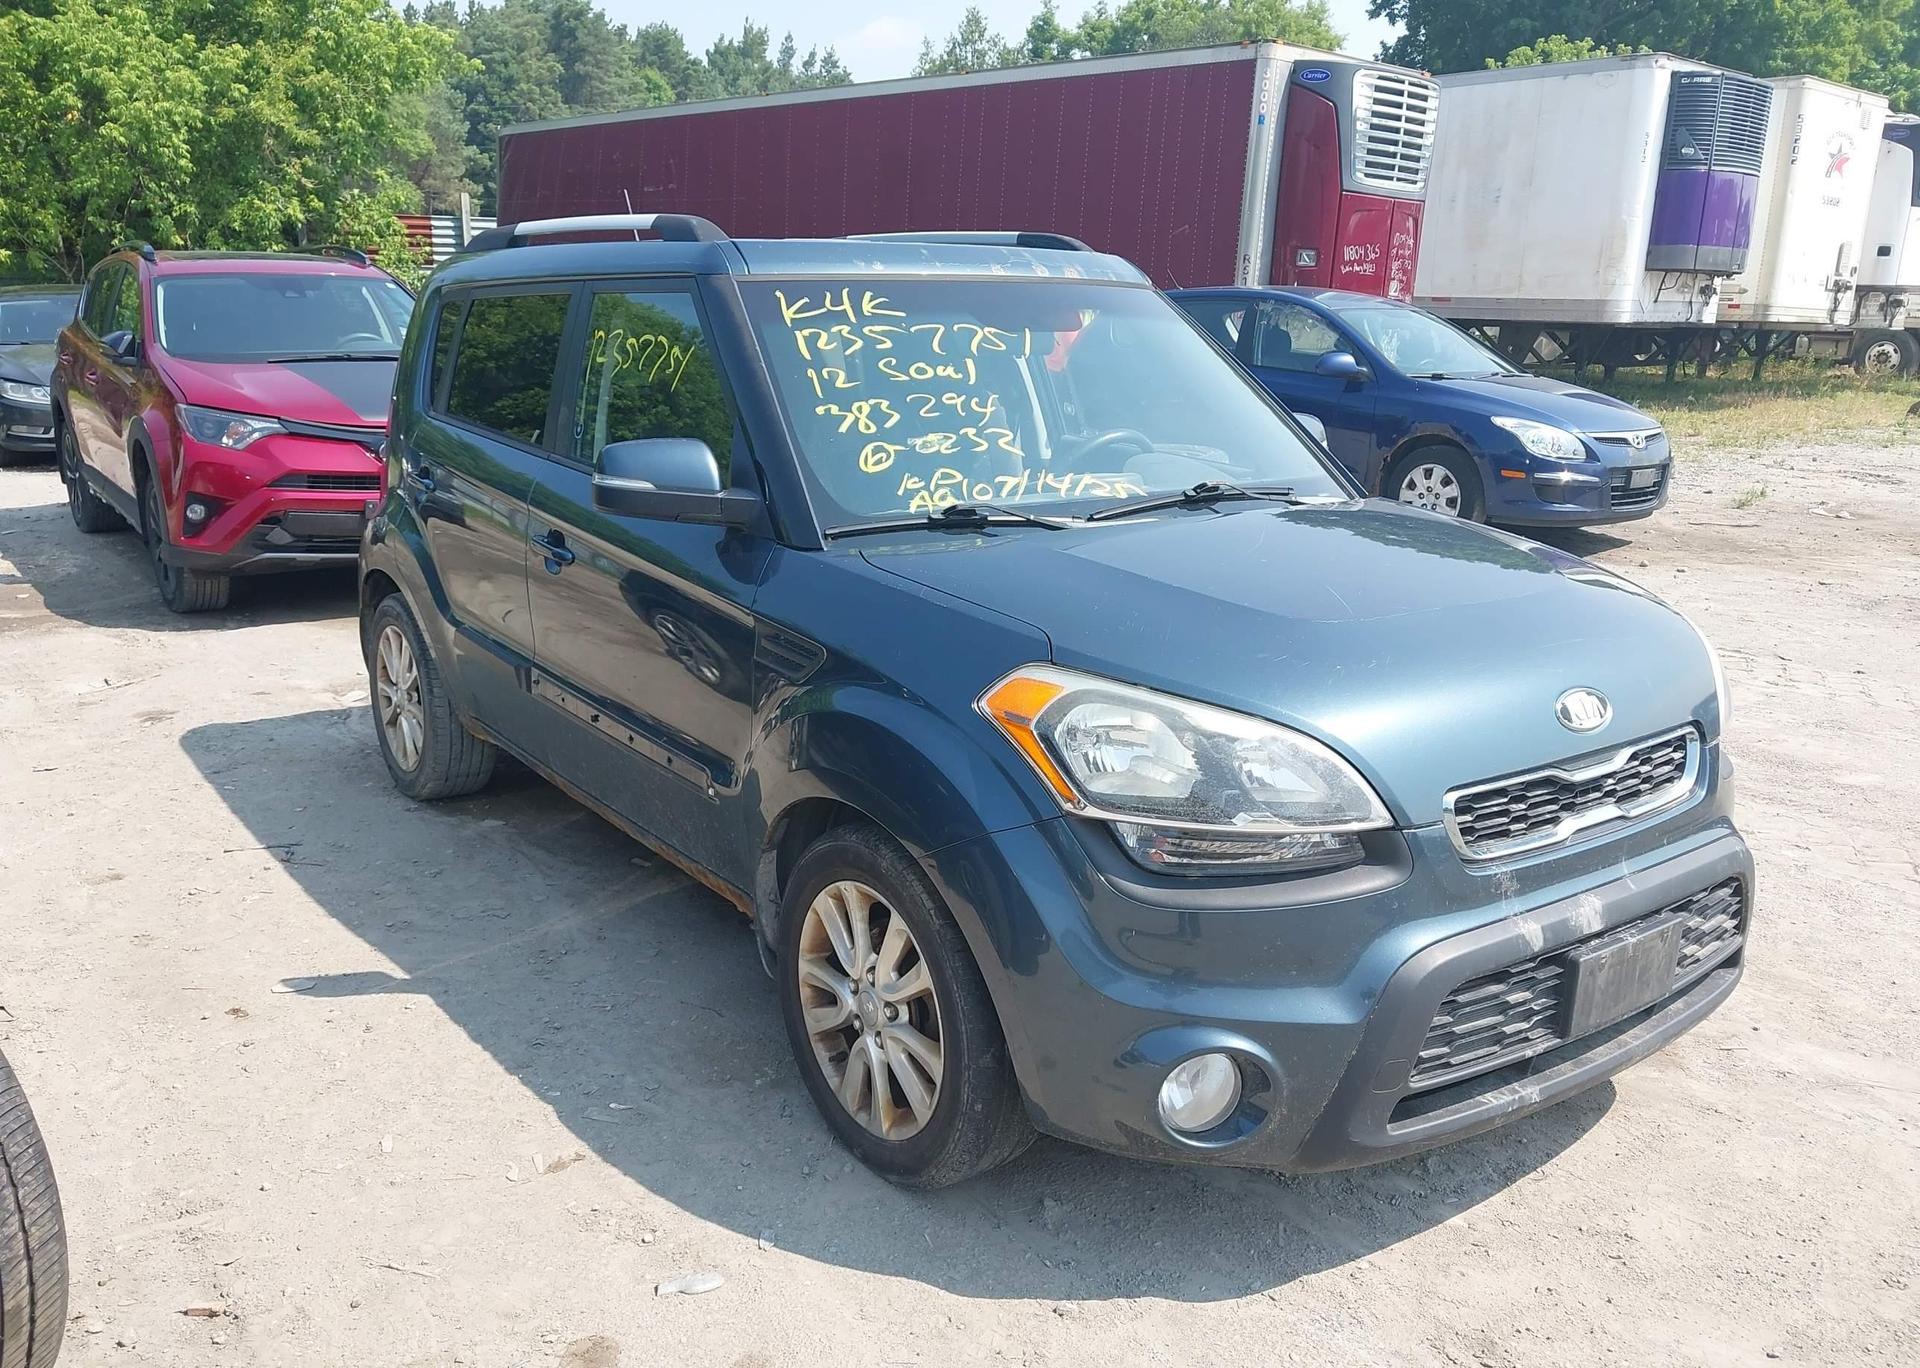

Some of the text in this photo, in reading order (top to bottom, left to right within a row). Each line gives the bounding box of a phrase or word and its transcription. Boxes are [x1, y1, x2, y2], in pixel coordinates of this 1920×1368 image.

[1303, 70, 1327, 80] Carrier
[774, 287, 907, 327] K4K
[794, 323, 1031, 361] 12357751
[807, 367, 862, 399] 12
[815, 392, 1000, 435] 383 294
